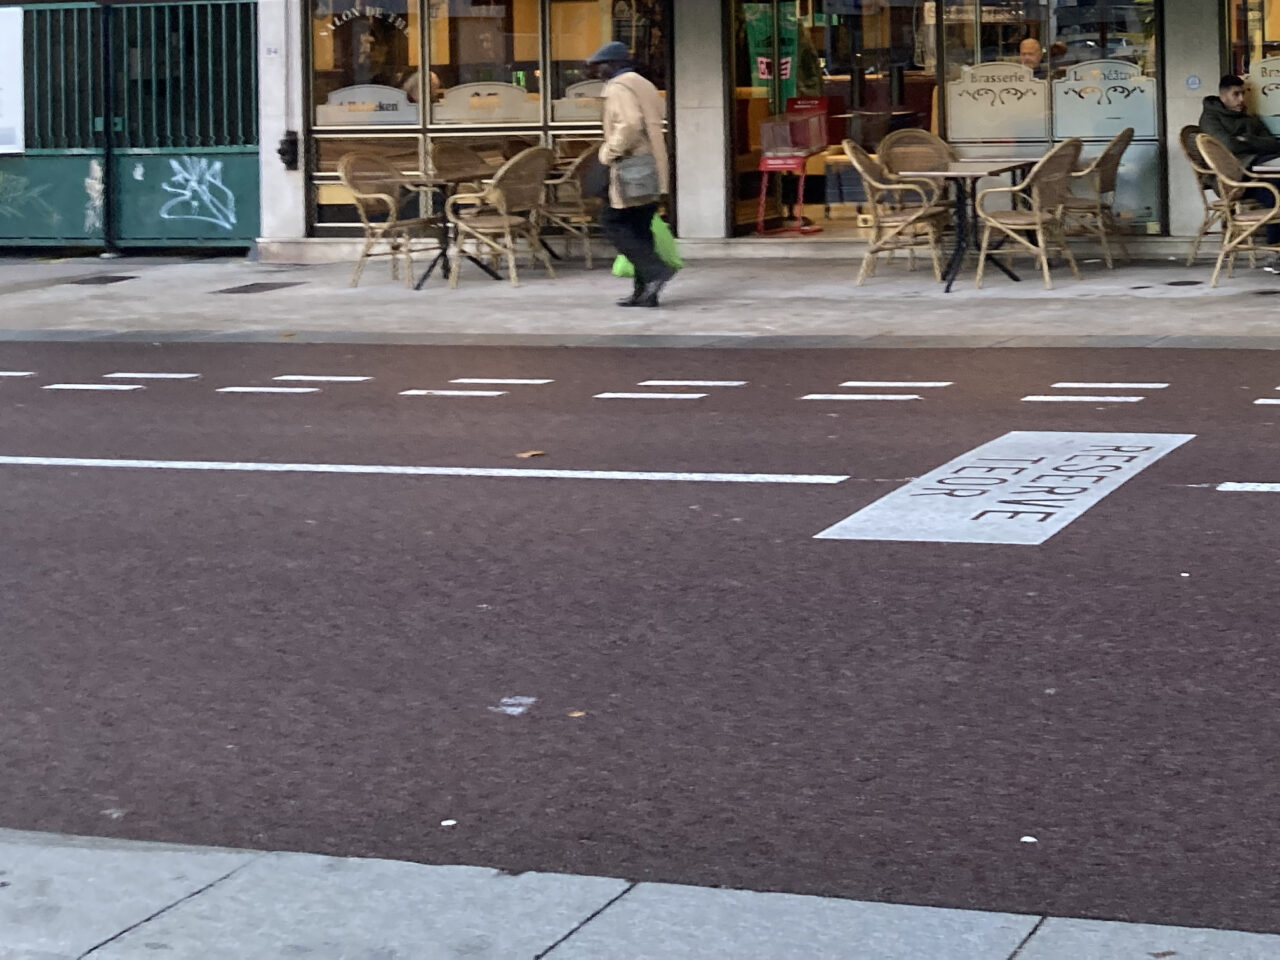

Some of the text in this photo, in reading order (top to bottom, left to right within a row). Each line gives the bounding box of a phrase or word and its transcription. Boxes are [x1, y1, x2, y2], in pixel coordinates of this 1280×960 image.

[970, 72, 1025, 83] Brasserie
[910, 456, 1047, 498] TEOR
[970, 444, 1155, 523] RESERVE
